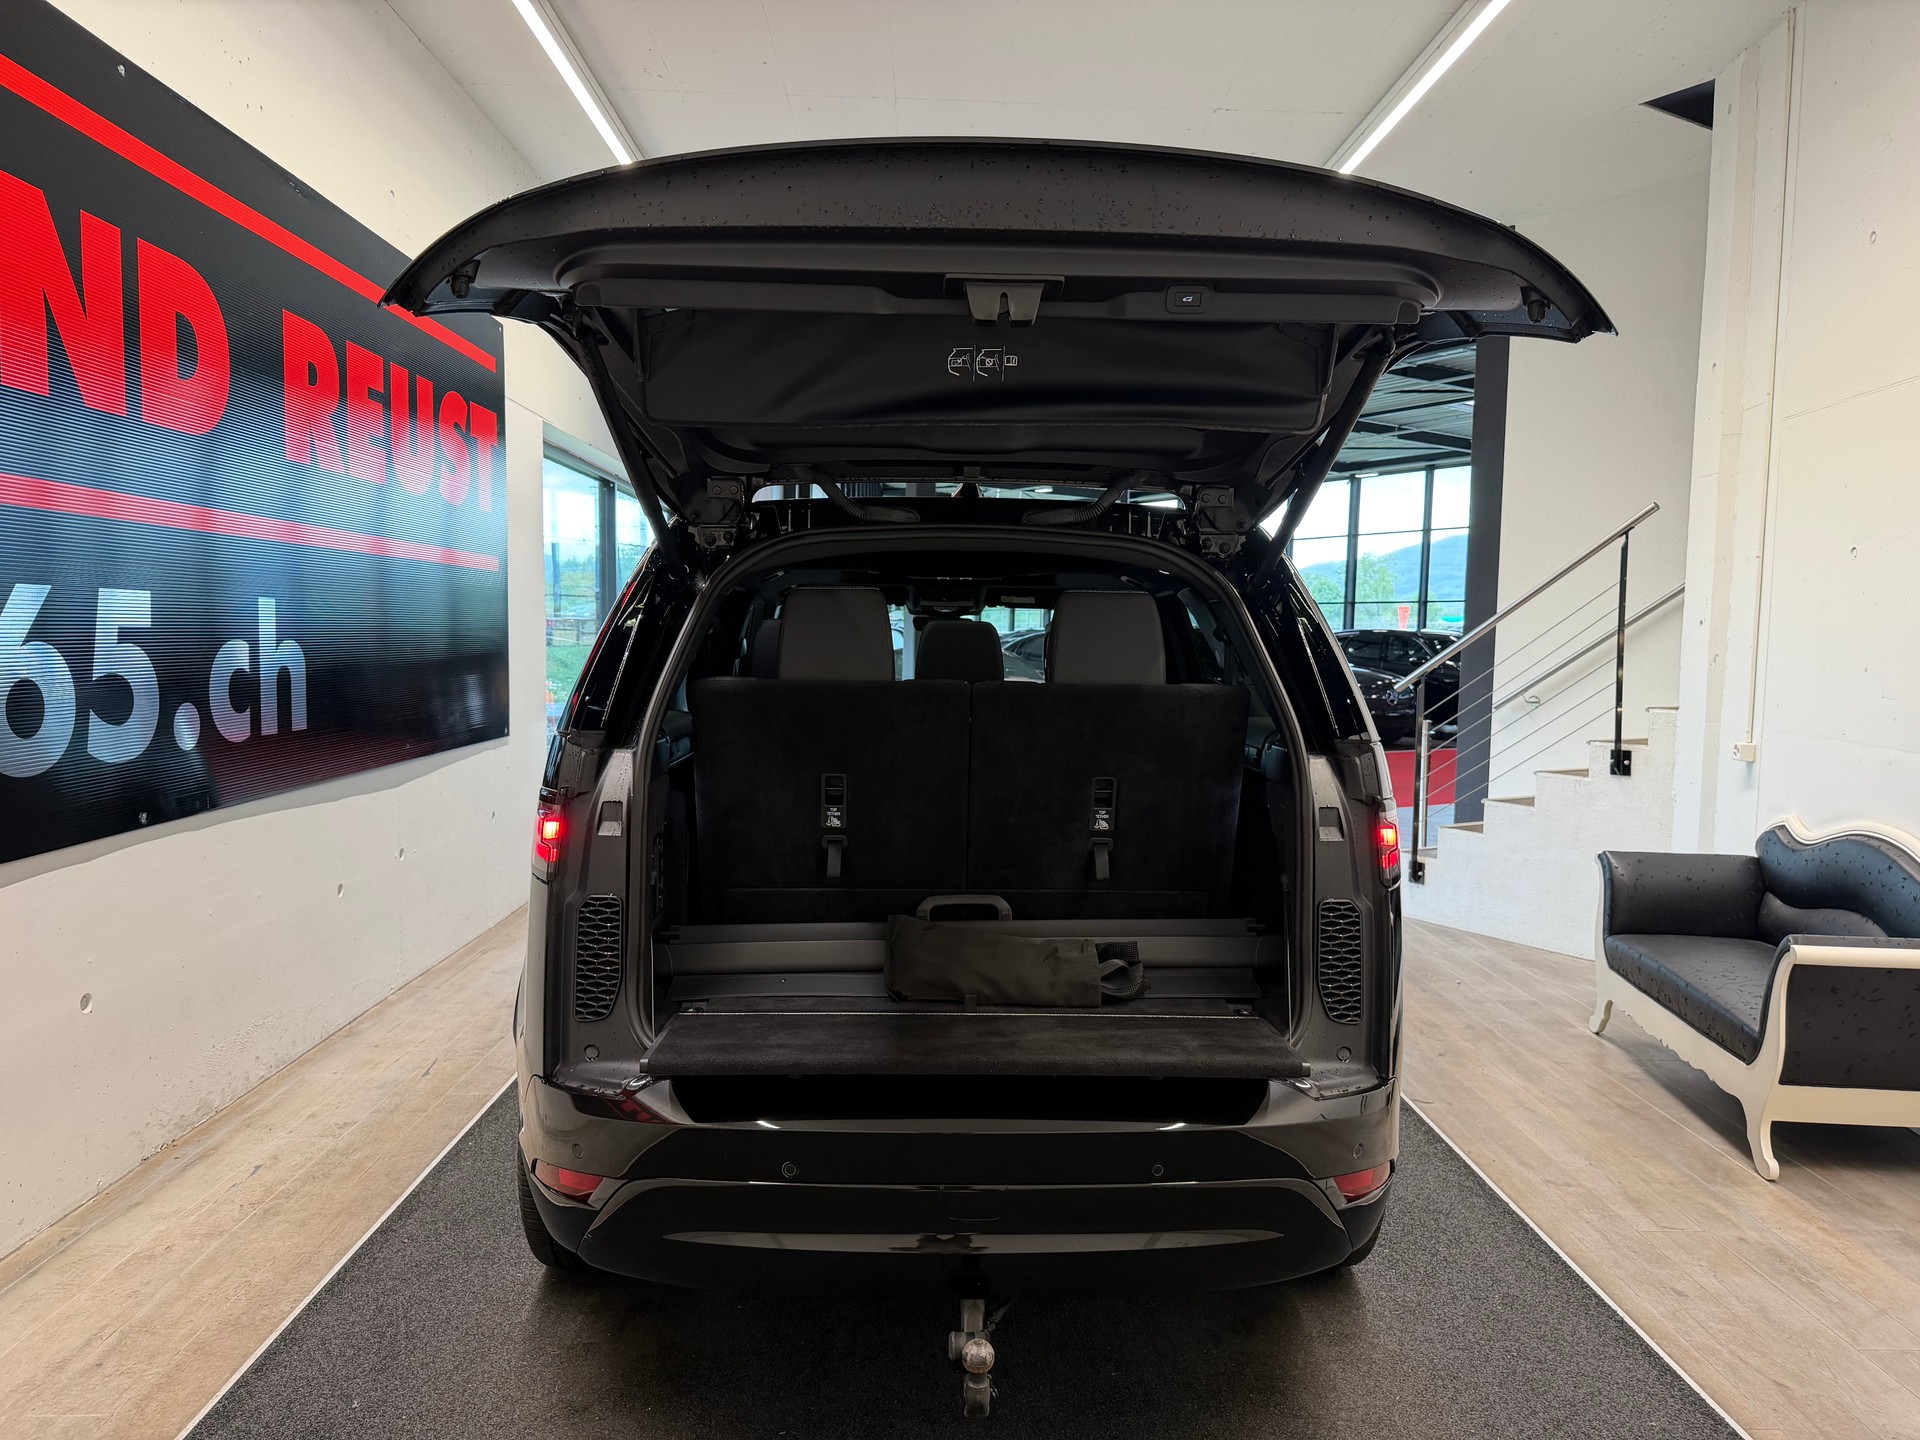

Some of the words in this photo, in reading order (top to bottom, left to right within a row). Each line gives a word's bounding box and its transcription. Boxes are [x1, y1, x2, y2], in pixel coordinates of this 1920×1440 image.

[0, 169, 231, 435] ND
[282, 309, 498, 512] REUST
[0, 583, 308, 778] 65.ch
